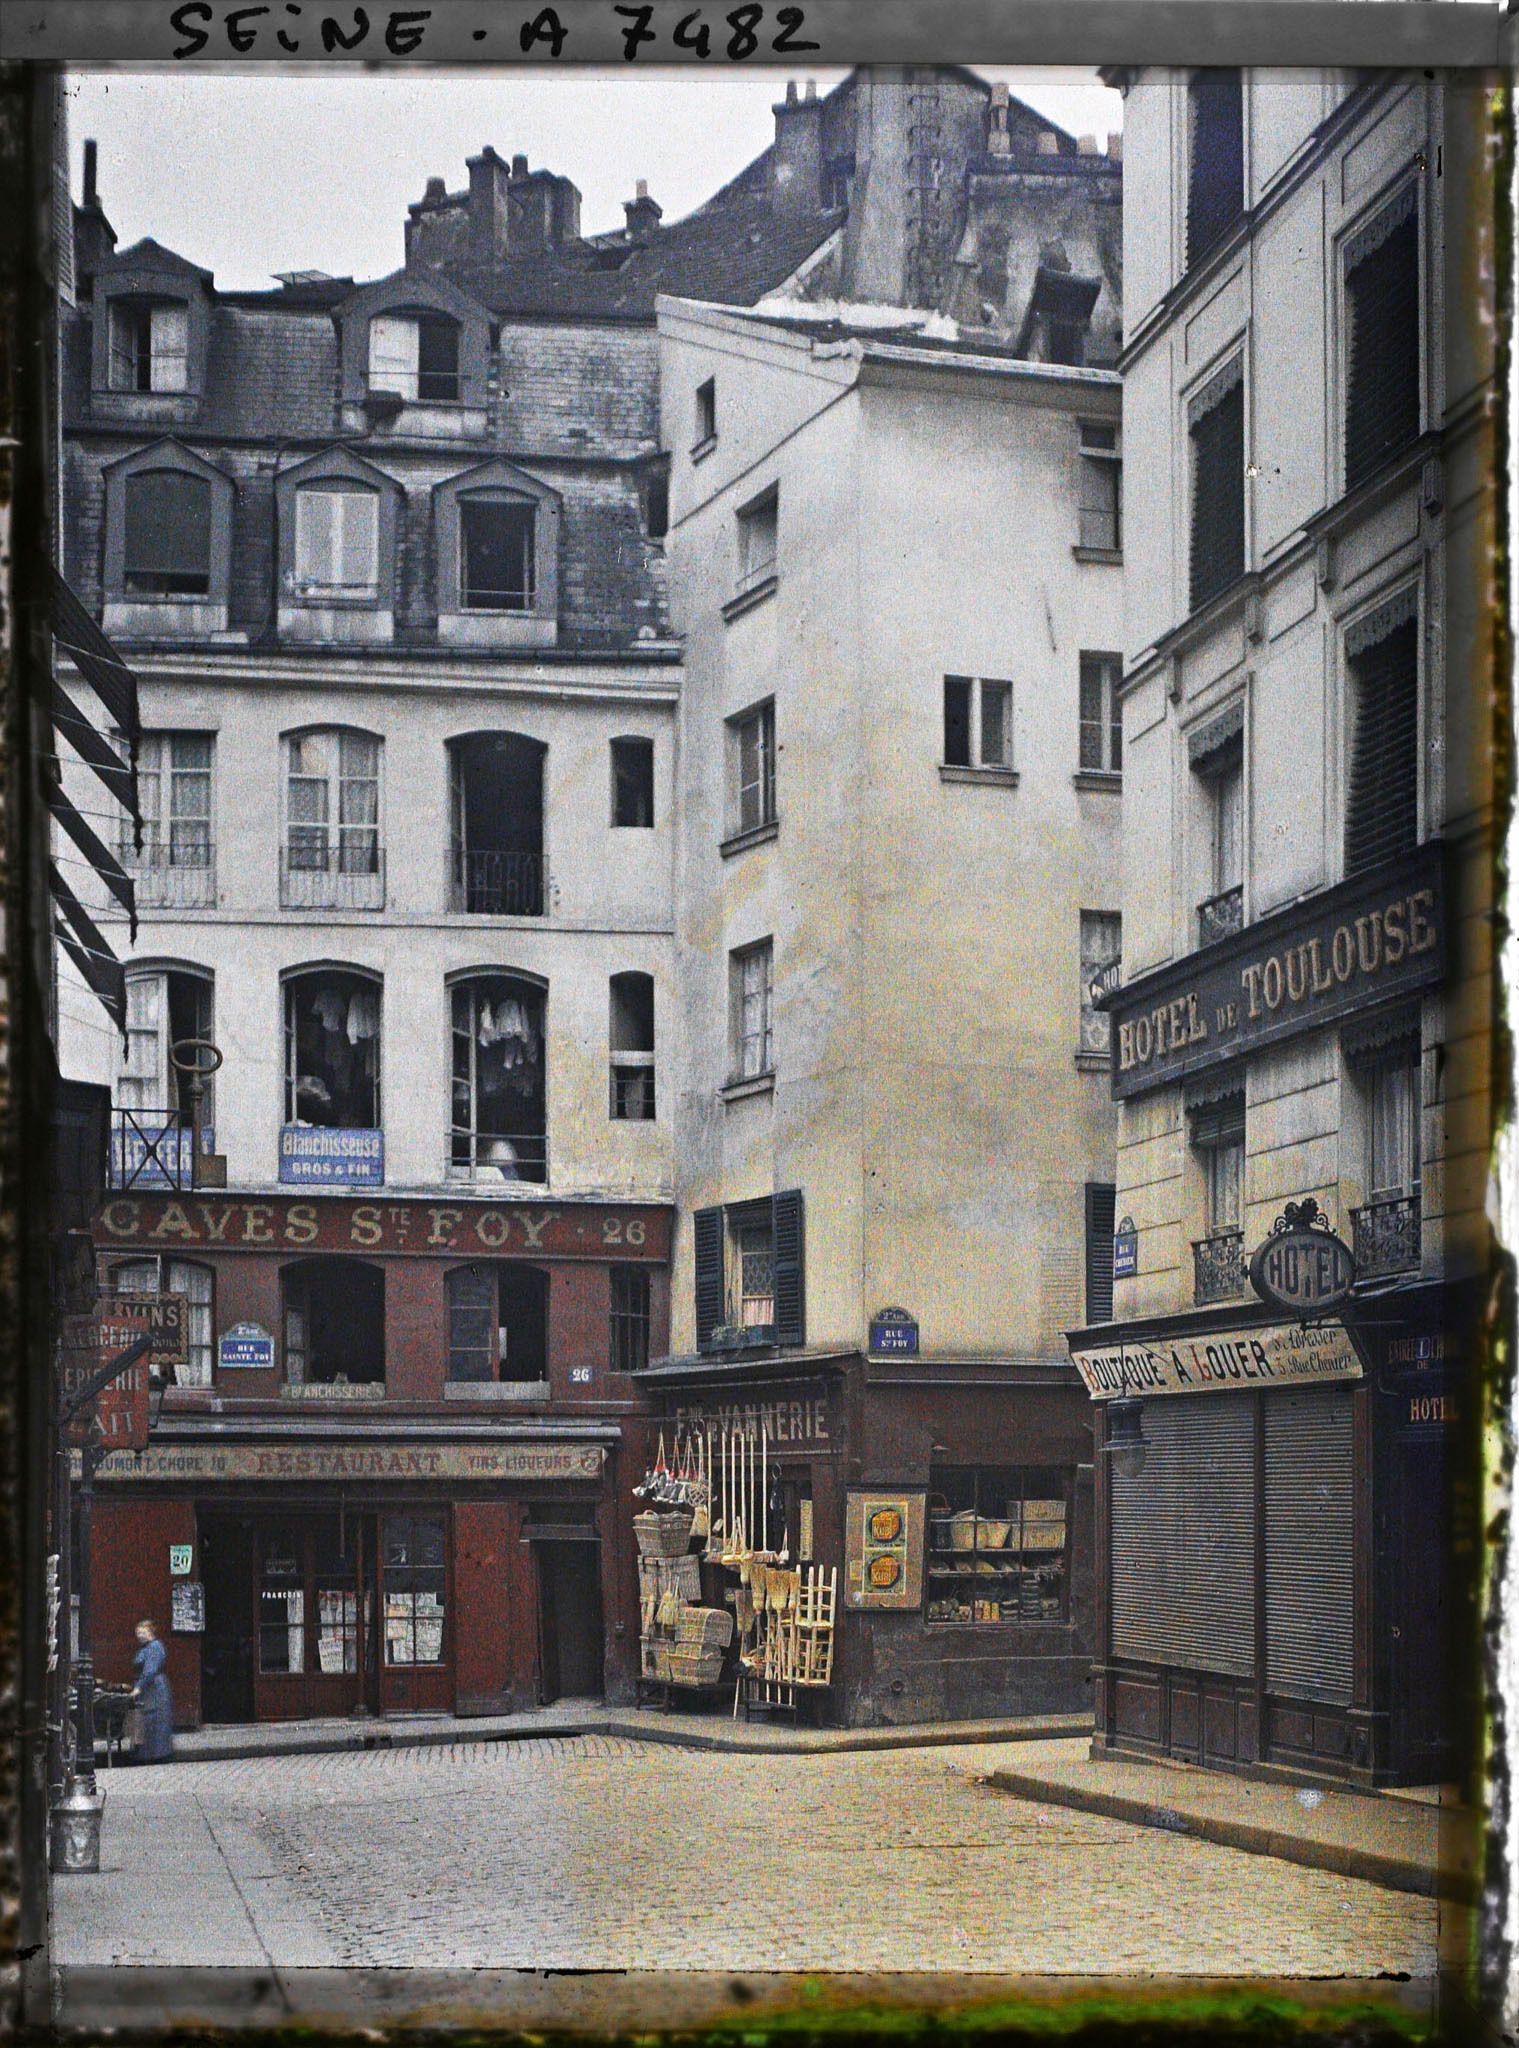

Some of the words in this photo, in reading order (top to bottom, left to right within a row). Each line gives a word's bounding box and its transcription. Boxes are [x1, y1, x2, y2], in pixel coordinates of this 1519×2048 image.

[520, 8, 568, 56] A
[620, 5, 821, 61] 7482
[1118, 992, 1208, 1070] HOTEL
[1216, 1002, 1237, 1033] DE
[1241, 889, 1437, 1021] TOULOUSE
[283, 1132, 380, 1158] Blanchisseuse
[292, 1162, 331, 1176] GROS
[348, 1163, 371, 1176] FIN
[101, 1200, 320, 1243] CAVES
[428, 1207, 561, 1248] FOY
[602, 1217, 646, 1245] 26
[1269, 1244, 1346, 1299] HOTEL
[885, 1329, 904, 1338] RUE
[893, 1340, 909, 1348] FOY
[572, 1368, 590, 1382] 26
[1079, 1352, 1168, 1392] BOUTIQUE
[1188, 1340, 1275, 1382] LOUER
[718, 1400, 829, 1442] VANNERIE
[257, 1450, 441, 1473] RESTAURANT
[172, 1555, 189, 1569] 20
